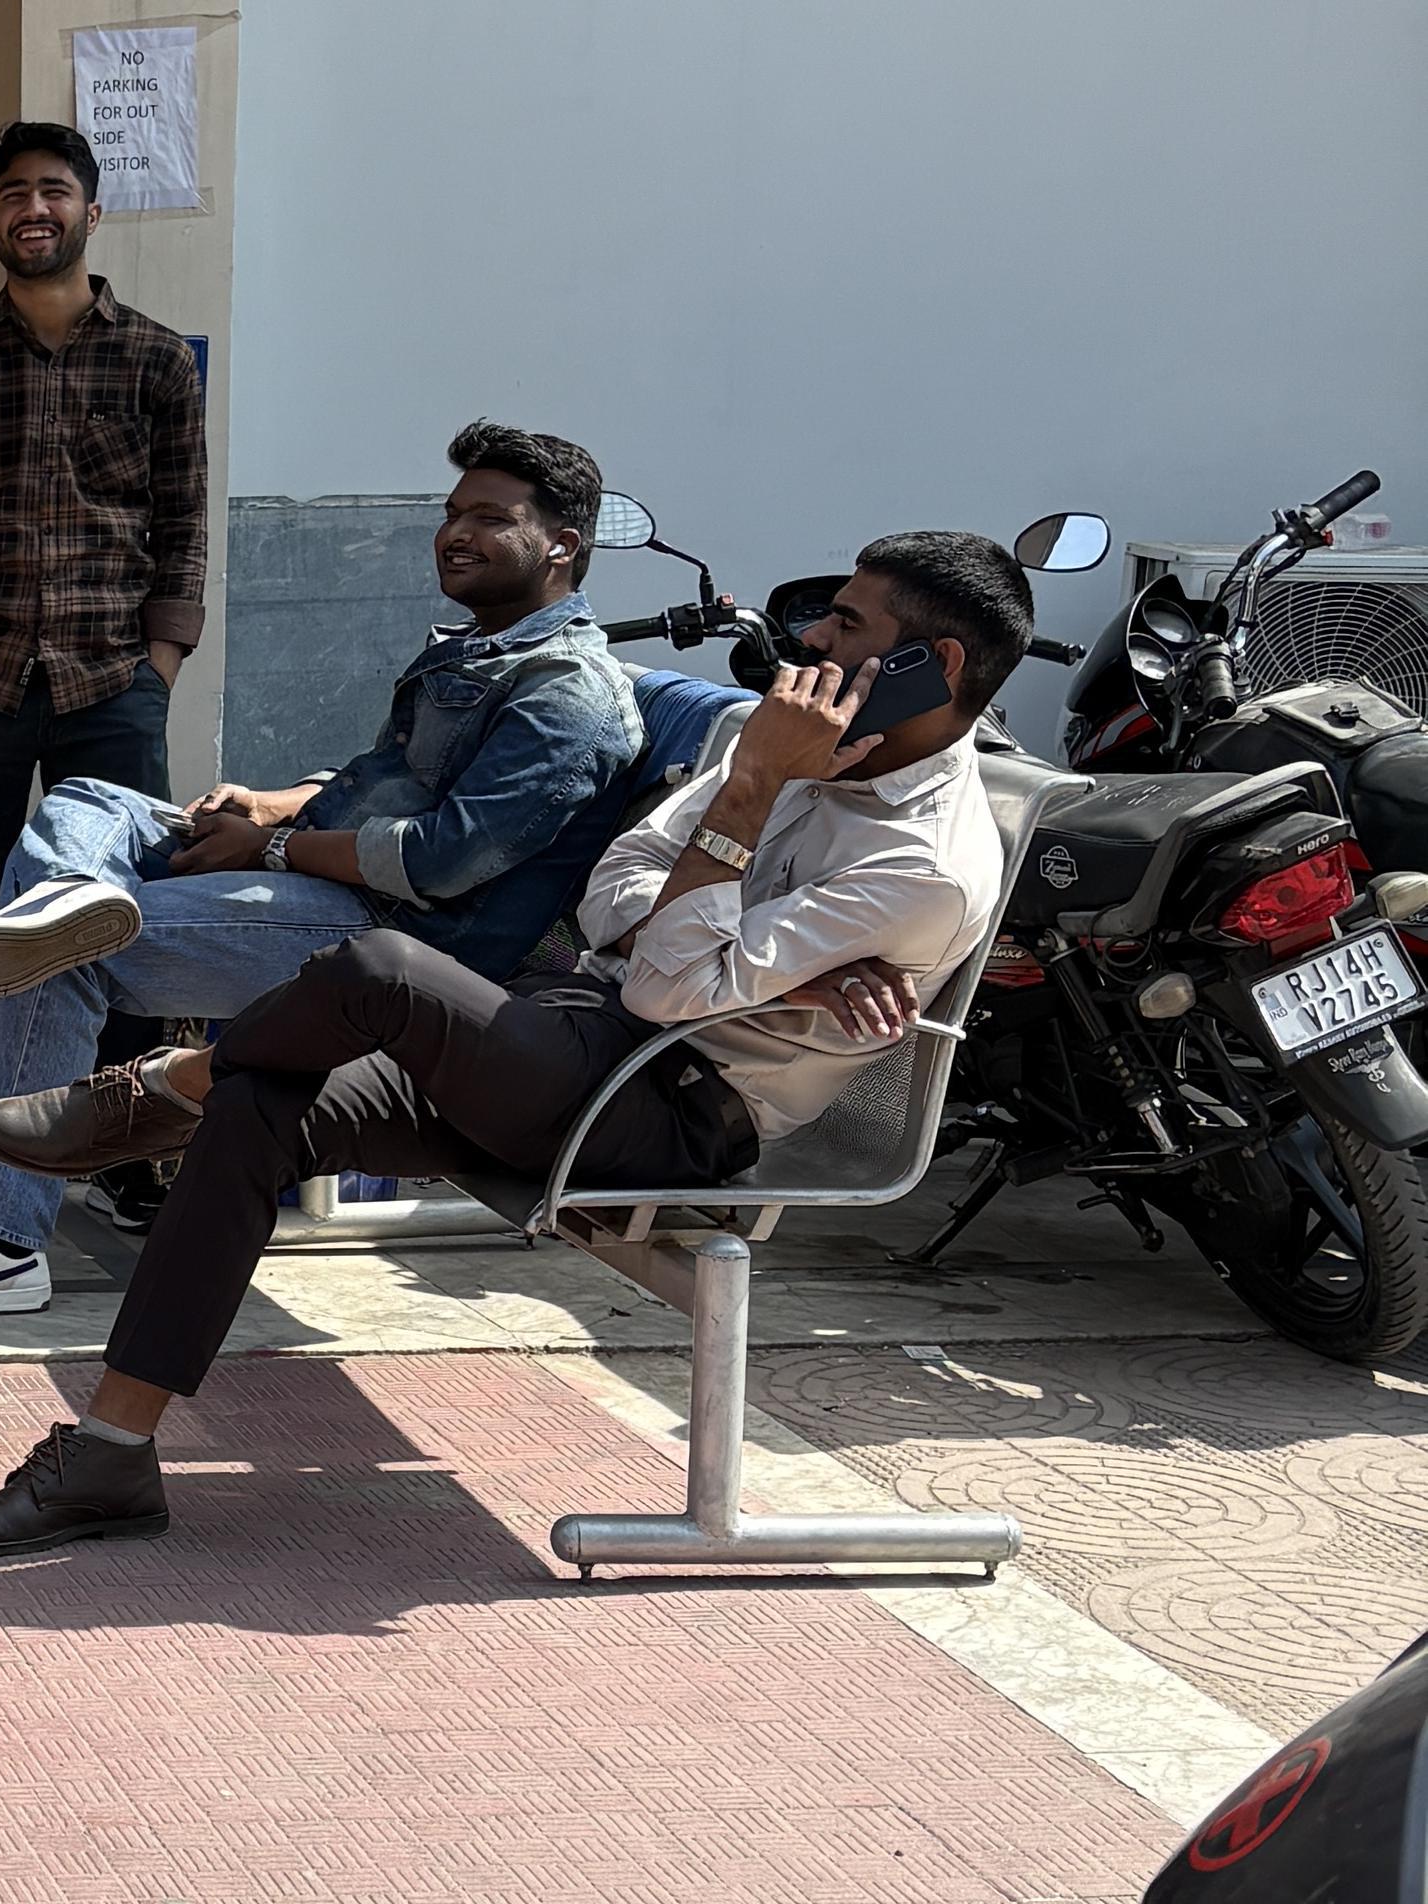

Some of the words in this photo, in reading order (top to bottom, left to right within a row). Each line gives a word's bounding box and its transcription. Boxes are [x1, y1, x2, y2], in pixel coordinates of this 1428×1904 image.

[121, 50, 145, 66] NO
[93, 77, 158, 94] PARKING
[93, 106, 122, 121] FOR
[127, 104, 158, 118] OUT
[93, 131, 126, 146] SIDE
[95, 156, 150, 172] VISITOR
[1296, 833, 1331, 856] Hero
[988, 946, 1028, 960] luxe
[1286, 940, 1383, 1002] RJ14H
[1301, 972, 1399, 1032] V2745
